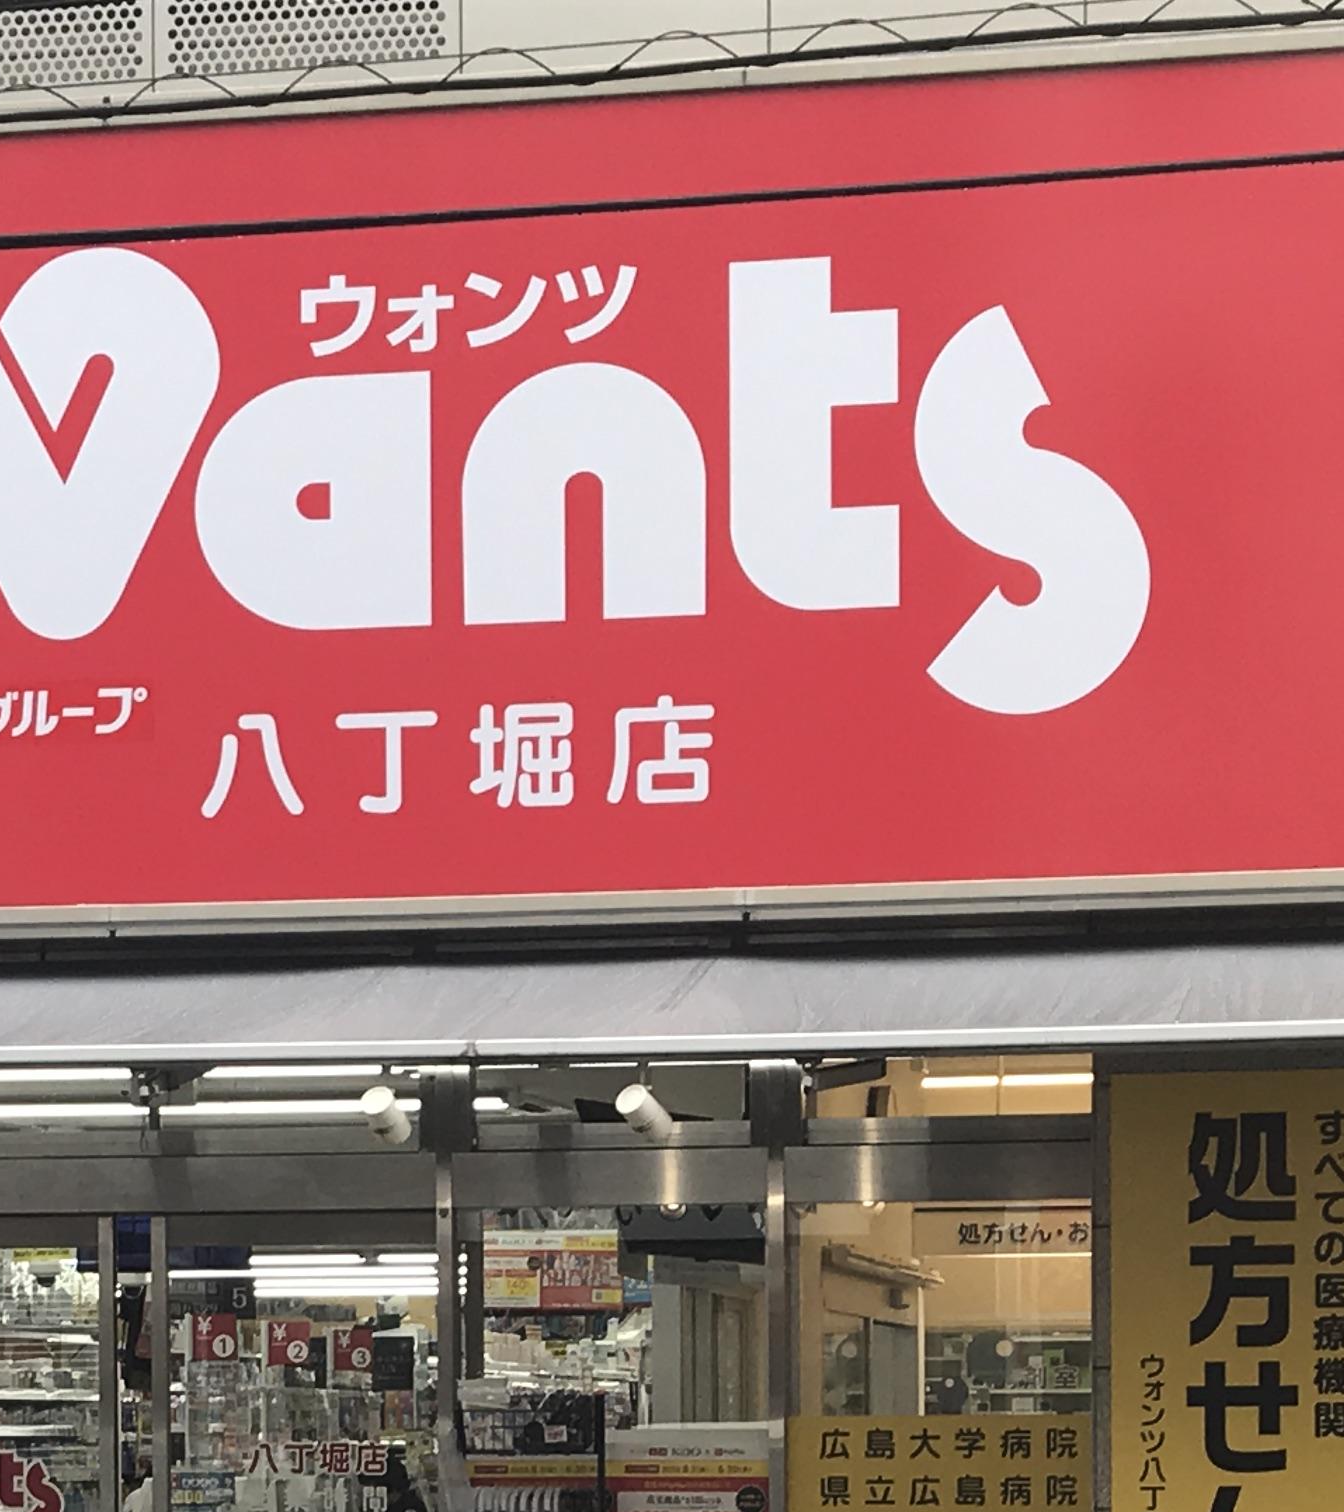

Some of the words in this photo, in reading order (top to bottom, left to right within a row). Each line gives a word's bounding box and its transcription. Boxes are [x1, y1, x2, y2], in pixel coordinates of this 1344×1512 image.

[298, 264, 639, 358] ウォンツ
[200, 694, 716, 819] 八丁堀店
[249, 1441, 388, 1475] 八丁堀店
[819, 1427, 1079, 1460] 広島大学病院
[819, 1474, 1079, 1507] 県立広島病院
